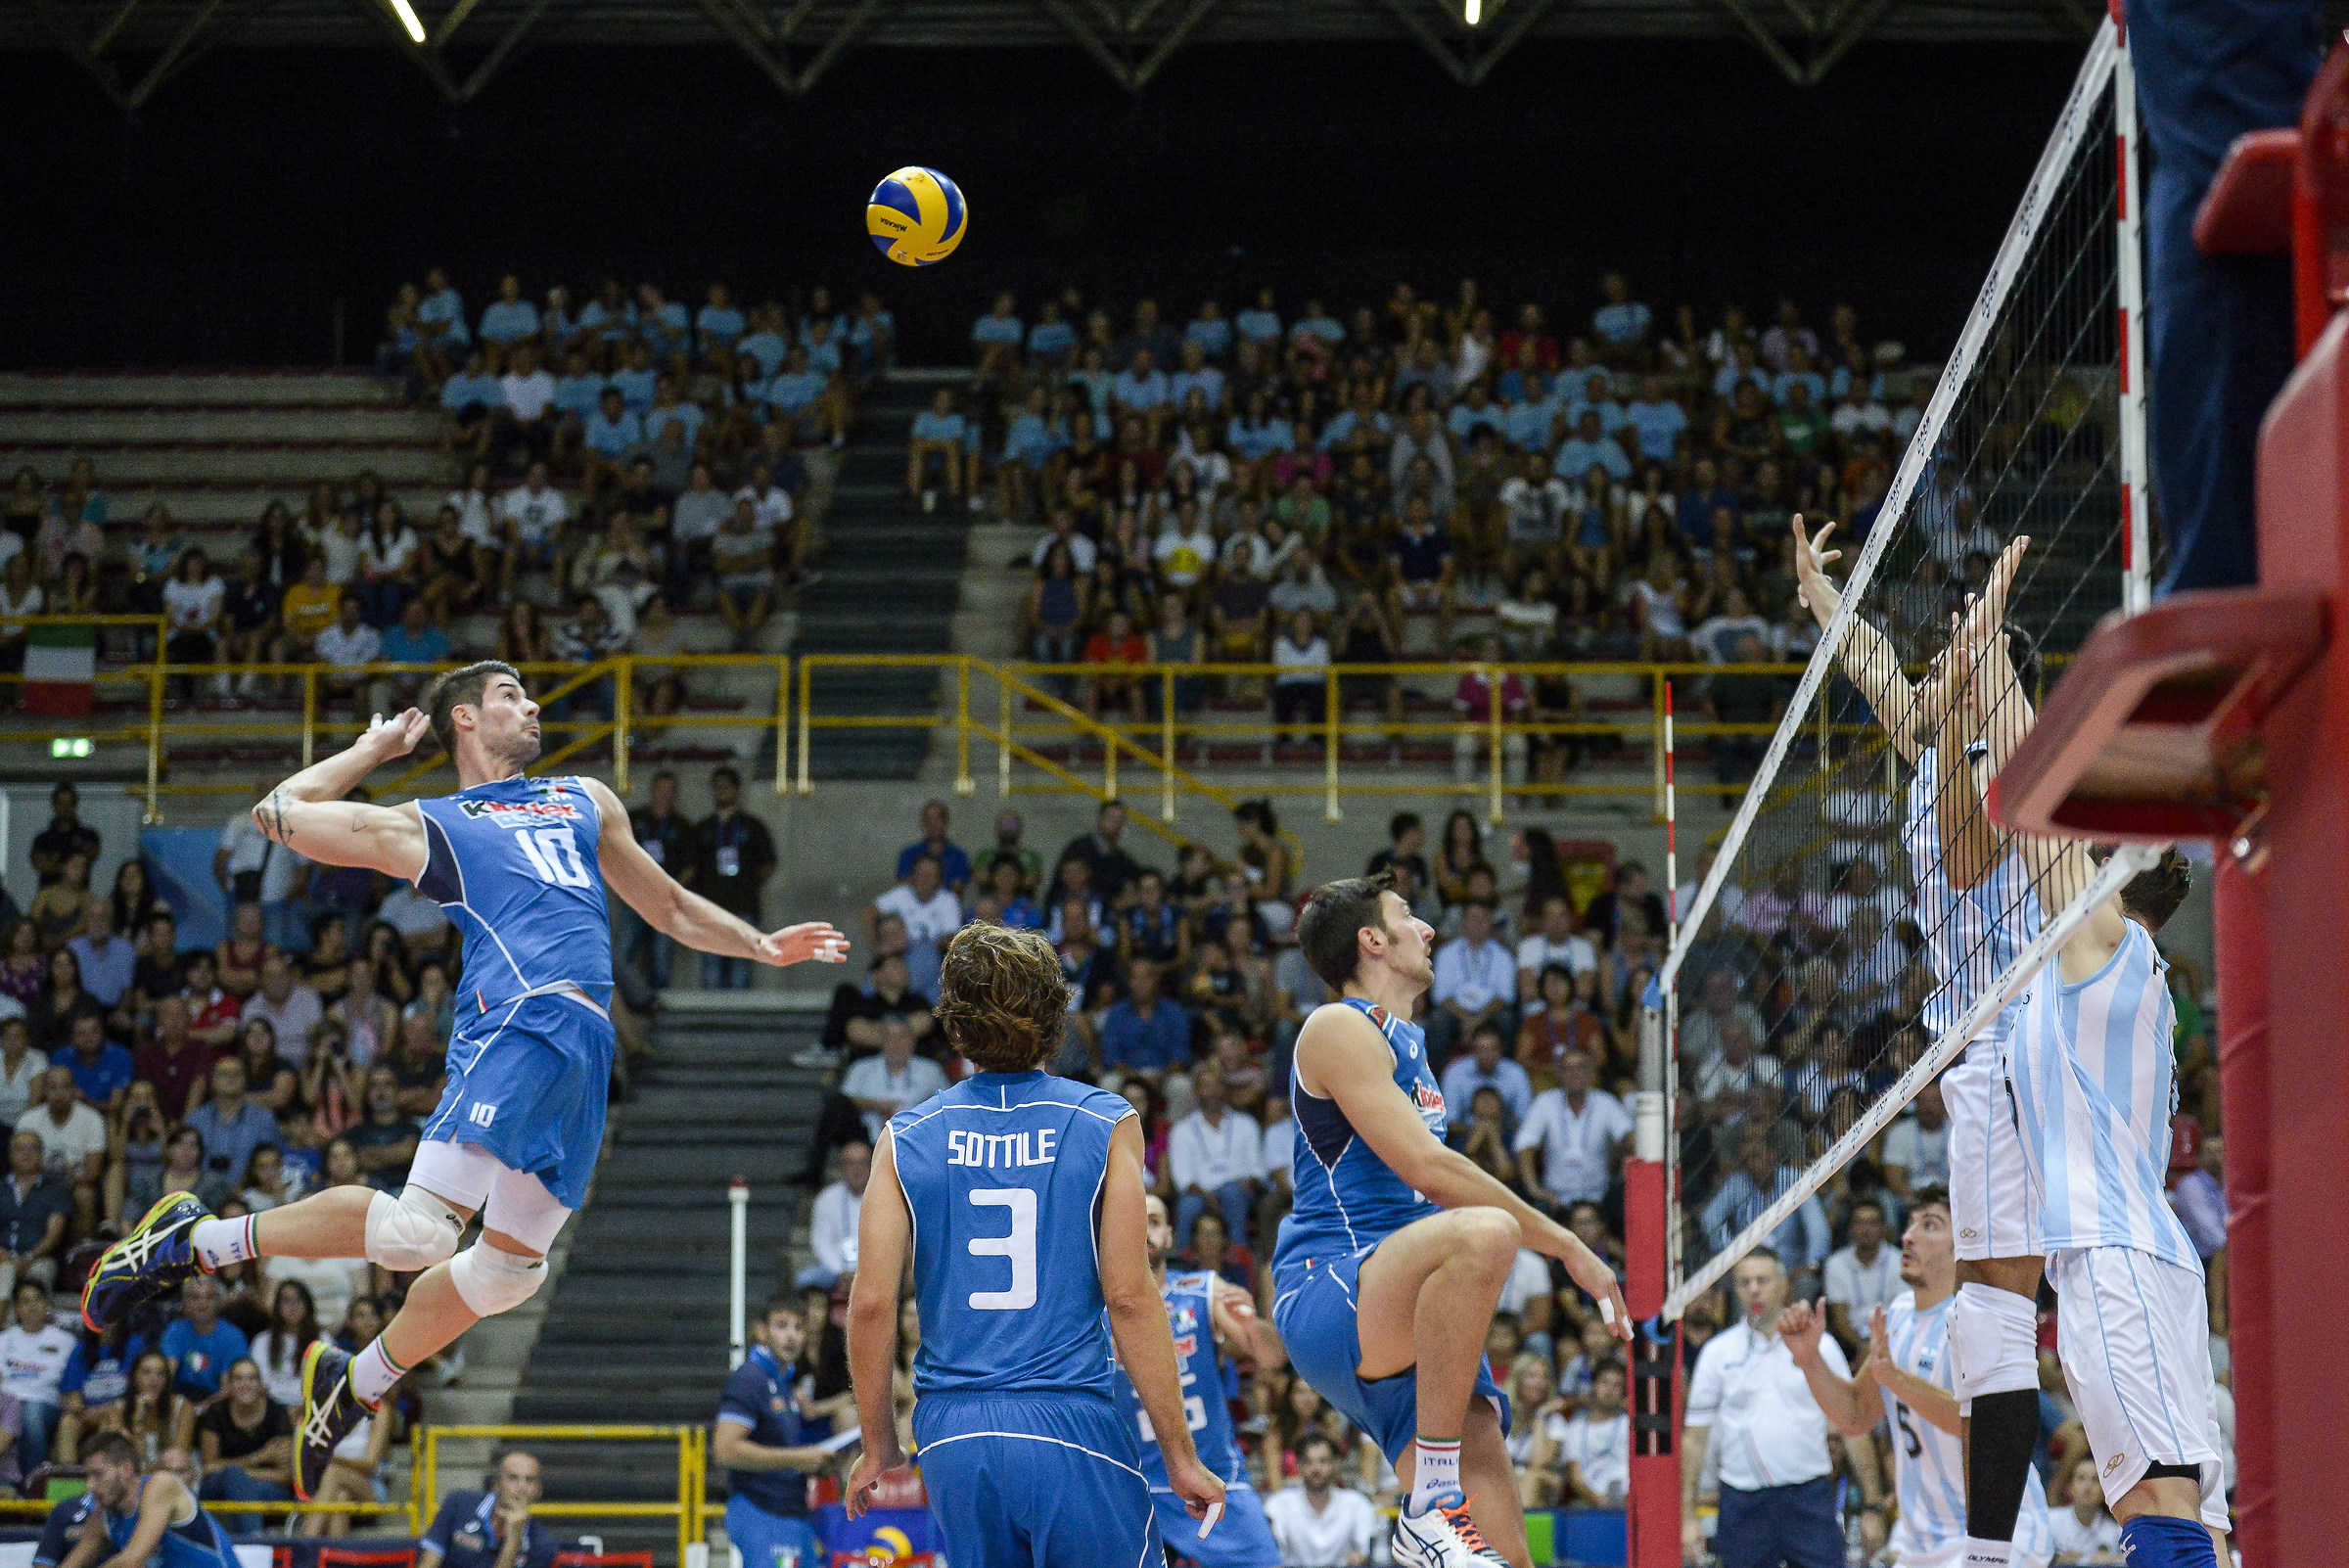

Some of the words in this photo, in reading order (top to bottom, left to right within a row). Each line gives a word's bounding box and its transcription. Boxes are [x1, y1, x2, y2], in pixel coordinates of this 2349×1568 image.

[515, 828, 591, 889] 10
[469, 1101, 497, 1129] 10
[947, 1129, 1056, 1169] SOTTILE
[968, 1188, 1037, 1310] 3
[1896, 1401, 1923, 1458] 5
[1423, 1456, 1458, 1466] ITALI
